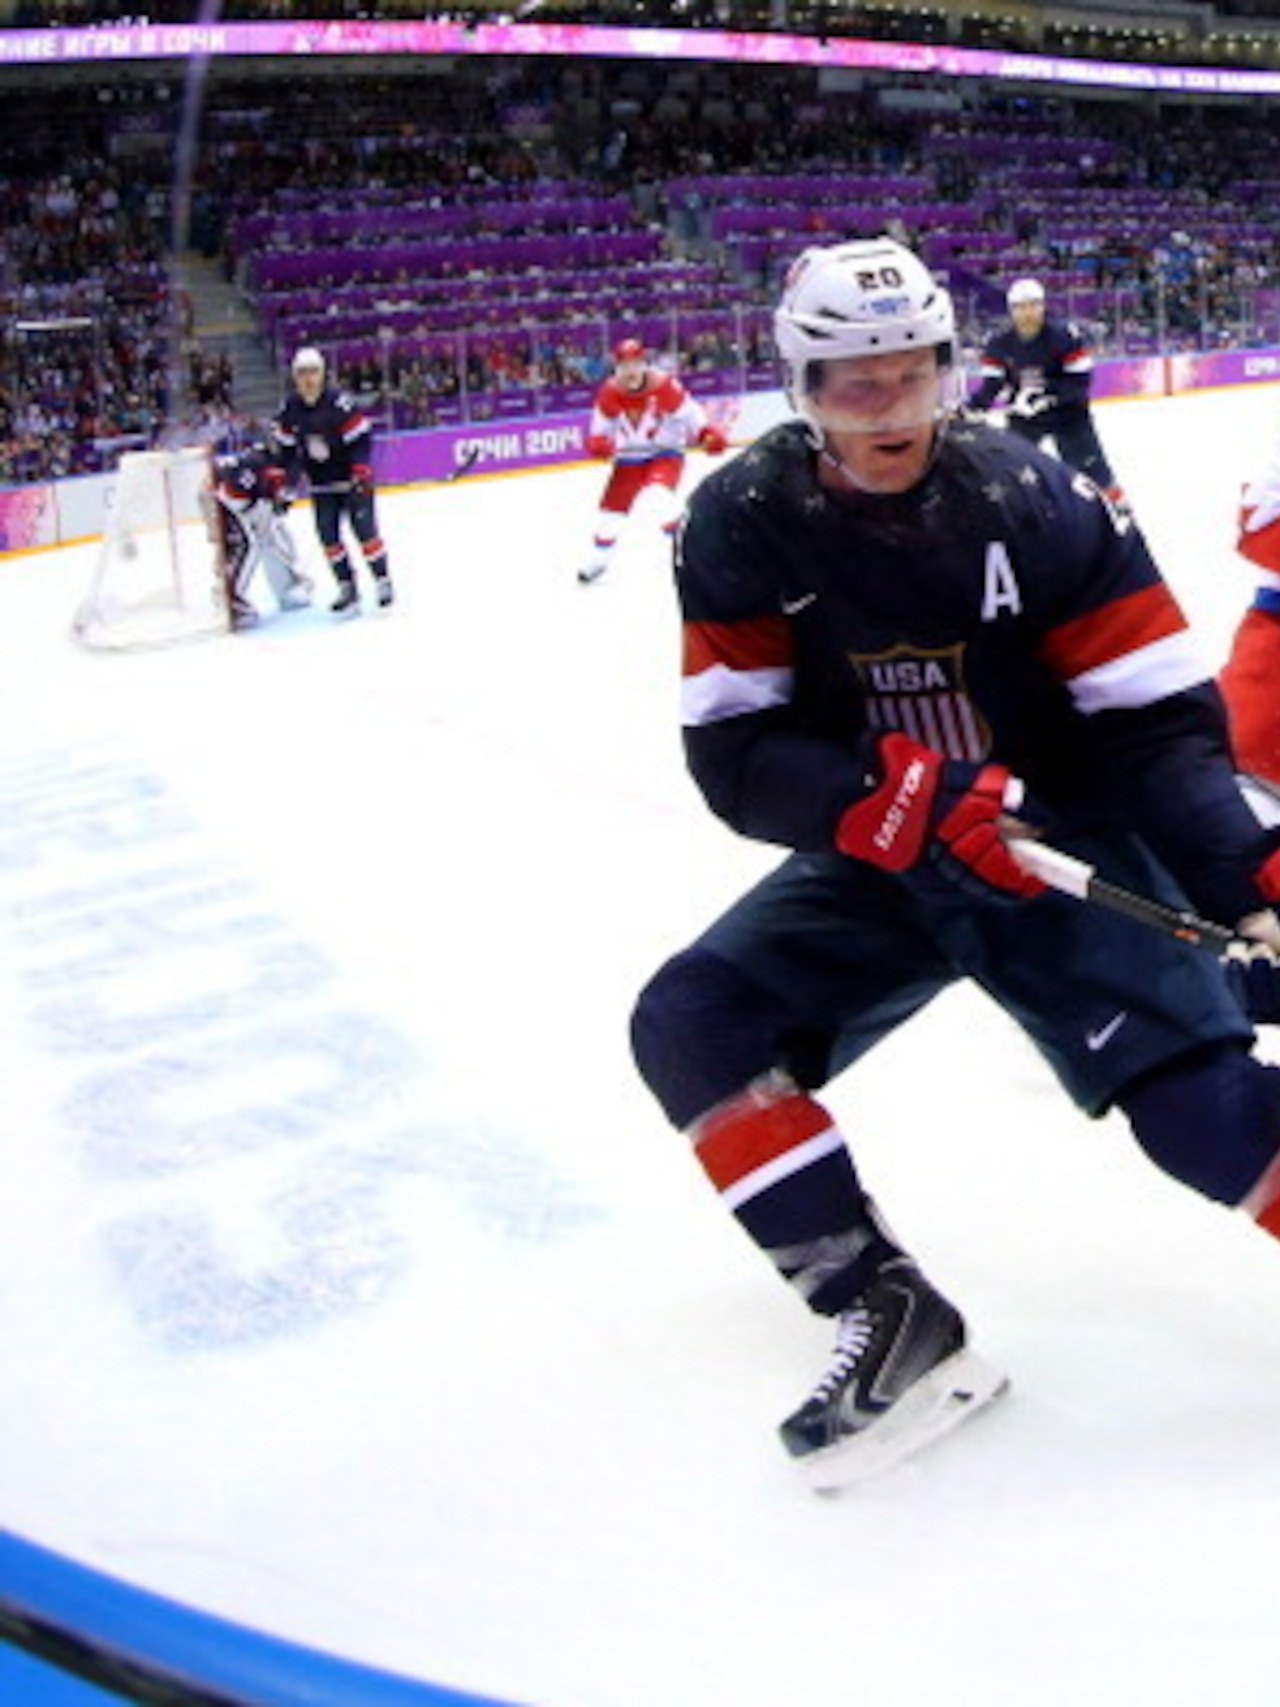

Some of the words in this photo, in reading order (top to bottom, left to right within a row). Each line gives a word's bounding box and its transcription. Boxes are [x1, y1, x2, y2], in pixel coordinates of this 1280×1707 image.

[855, 266, 904, 292] 20
[454, 433, 521, 467] СОЧИ
[525, 425, 584, 456] 2014
[981, 540, 1022, 622] A
[869, 661, 949, 692] USA
[873, 757, 925, 851] EASTON
